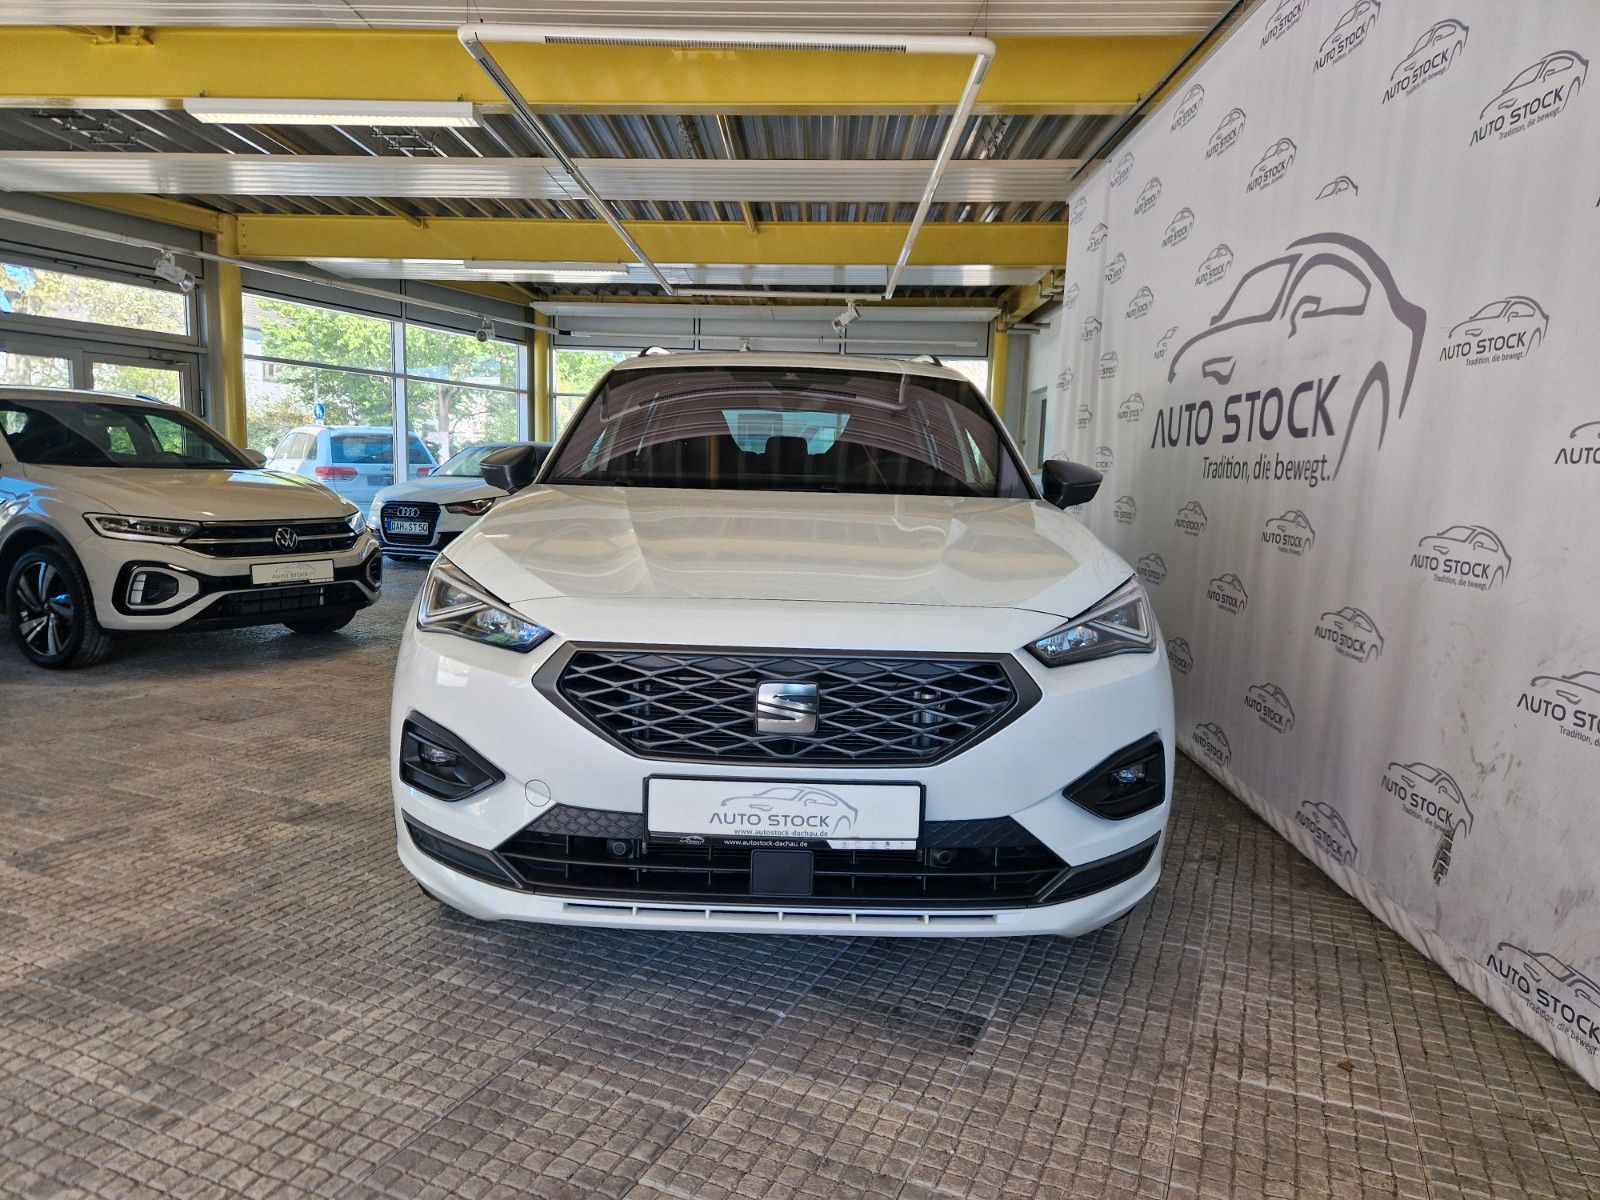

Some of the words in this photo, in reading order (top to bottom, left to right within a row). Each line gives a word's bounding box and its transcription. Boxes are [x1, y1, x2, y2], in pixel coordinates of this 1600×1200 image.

[1313, 47, 1335, 72] AUTO
[1337, 21, 1366, 54] STOCK
[1382, 76, 1410, 104] AUTO
[1411, 48, 1449, 84] STOCK
[1470, 115, 1505, 146] AUTO
[1510, 85, 1564, 125] STOCK
[1440, 342, 1471, 361] AUTO
[1476, 331, 1526, 354] STOCK
[1151, 401, 1213, 448] AUTO
[1222, 374, 1341, 443] STOCK
[1202, 456, 1250, 483] Tradition,
[1253, 453, 1271, 480] die
[1274, 453, 1331, 488] bewegt.
[1262, 532, 1281, 544] AUTO
[1282, 534, 1302, 548] STOCK
[1410, 554, 1438, 570] AUTO
[1443, 559, 1490, 579] STOCK
[1207, 590, 1220, 602] AUTO
[1221, 594, 1238, 609] STOCK
[1315, 626, 1337, 643] AUTO
[1339, 636, 1365, 655] STOCK
[1244, 696, 1261, 712] AUTO
[1263, 706, 1283, 726] STOCK
[1517, 694, 1566, 721] AUTO
[1573, 709, 1600, 734] ST
[1560, 725, 1592, 745] Tradition,
[1381, 775, 1407, 800] AUTO
[1410, 793, 1452, 827] STOCK
[709, 812, 761, 826] AUTO
[768, 814, 829, 828] STOCK
[734, 828, 829, 837] www.autostock-dachau.de
[724, 839, 808, 848] www.autostock-dachau.de
[1487, 954, 1530, 994] AUTO
[1536, 988, 1600, 1046] STOCK
